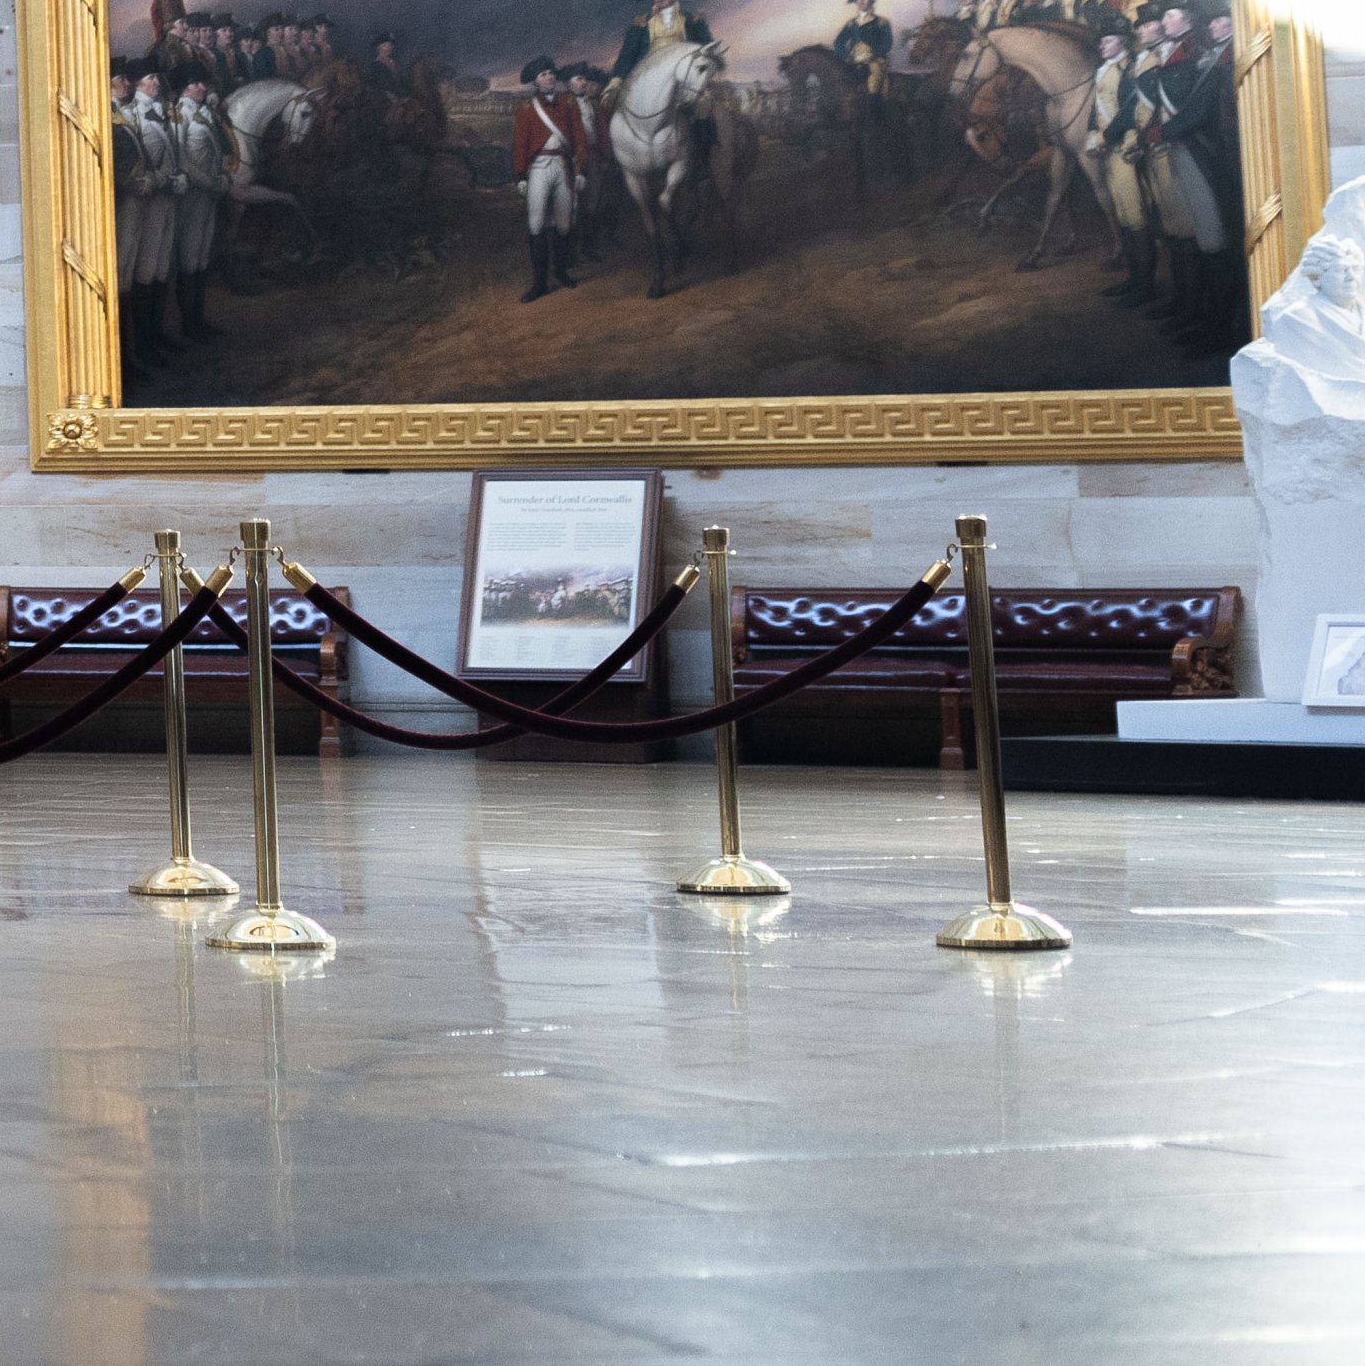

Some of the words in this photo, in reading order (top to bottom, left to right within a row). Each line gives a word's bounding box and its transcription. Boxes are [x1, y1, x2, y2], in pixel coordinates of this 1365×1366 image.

[498, 494, 544, 505] Surrender
[545, 494, 556, 505] of
[558, 494, 580, 505] Lord
[582, 494, 633, 505] Cornwallis
